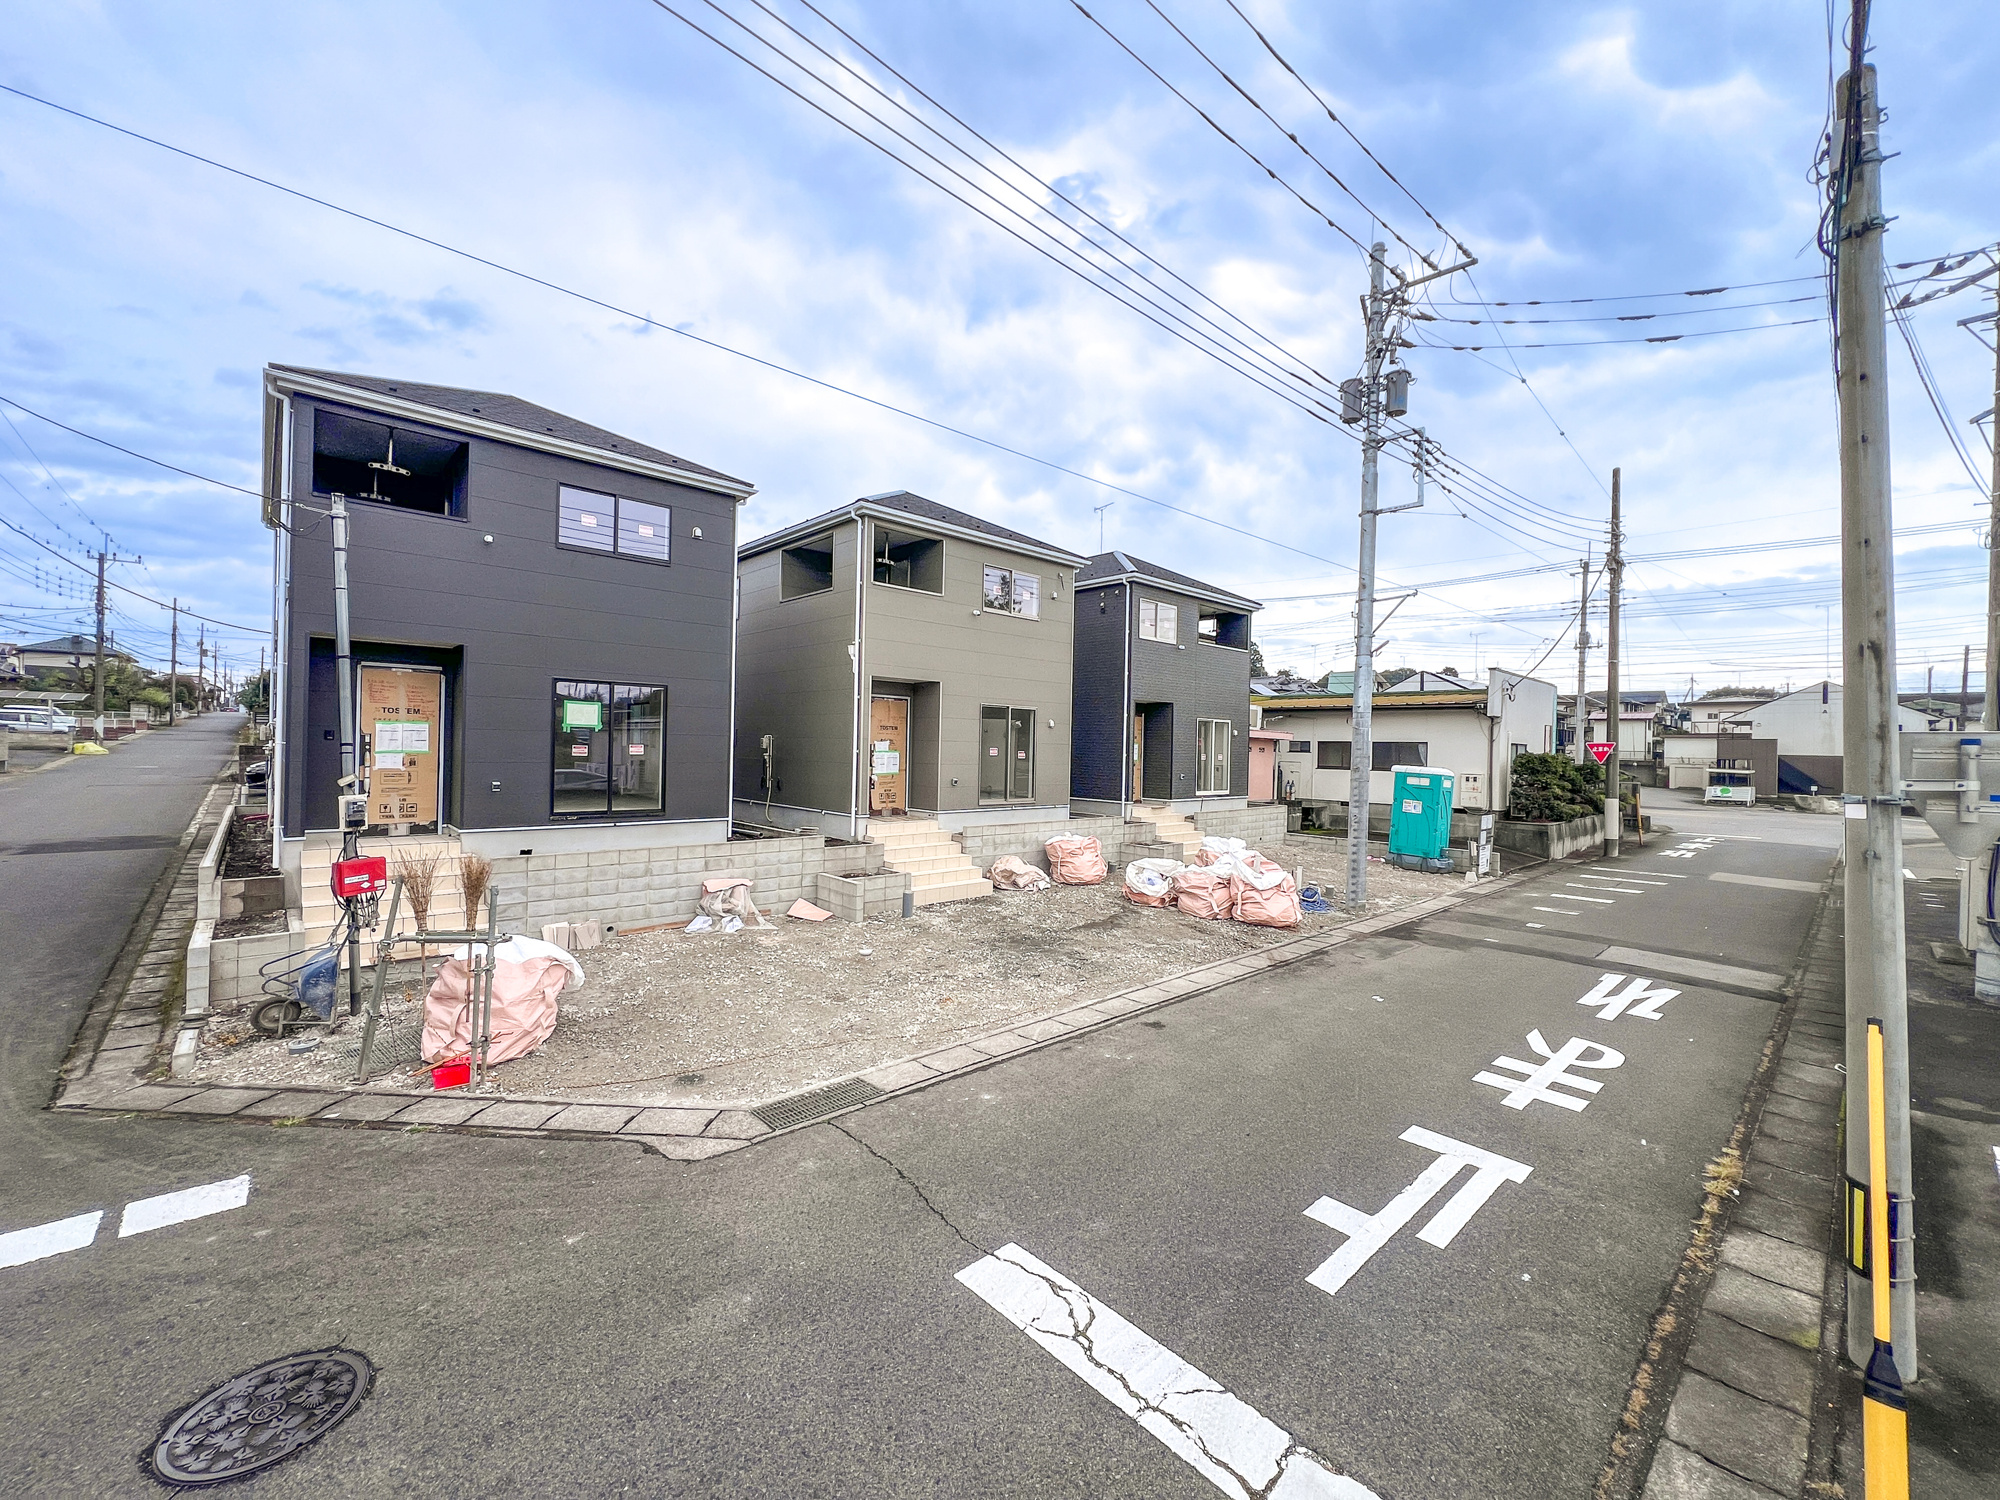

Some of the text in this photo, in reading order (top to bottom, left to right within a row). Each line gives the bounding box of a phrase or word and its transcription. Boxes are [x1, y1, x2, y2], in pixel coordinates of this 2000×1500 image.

[382, 707, 421, 715] TOSEM
[1656, 837, 1725, 858] 止まれ
[1302, 972, 1682, 1296] 止まれ
